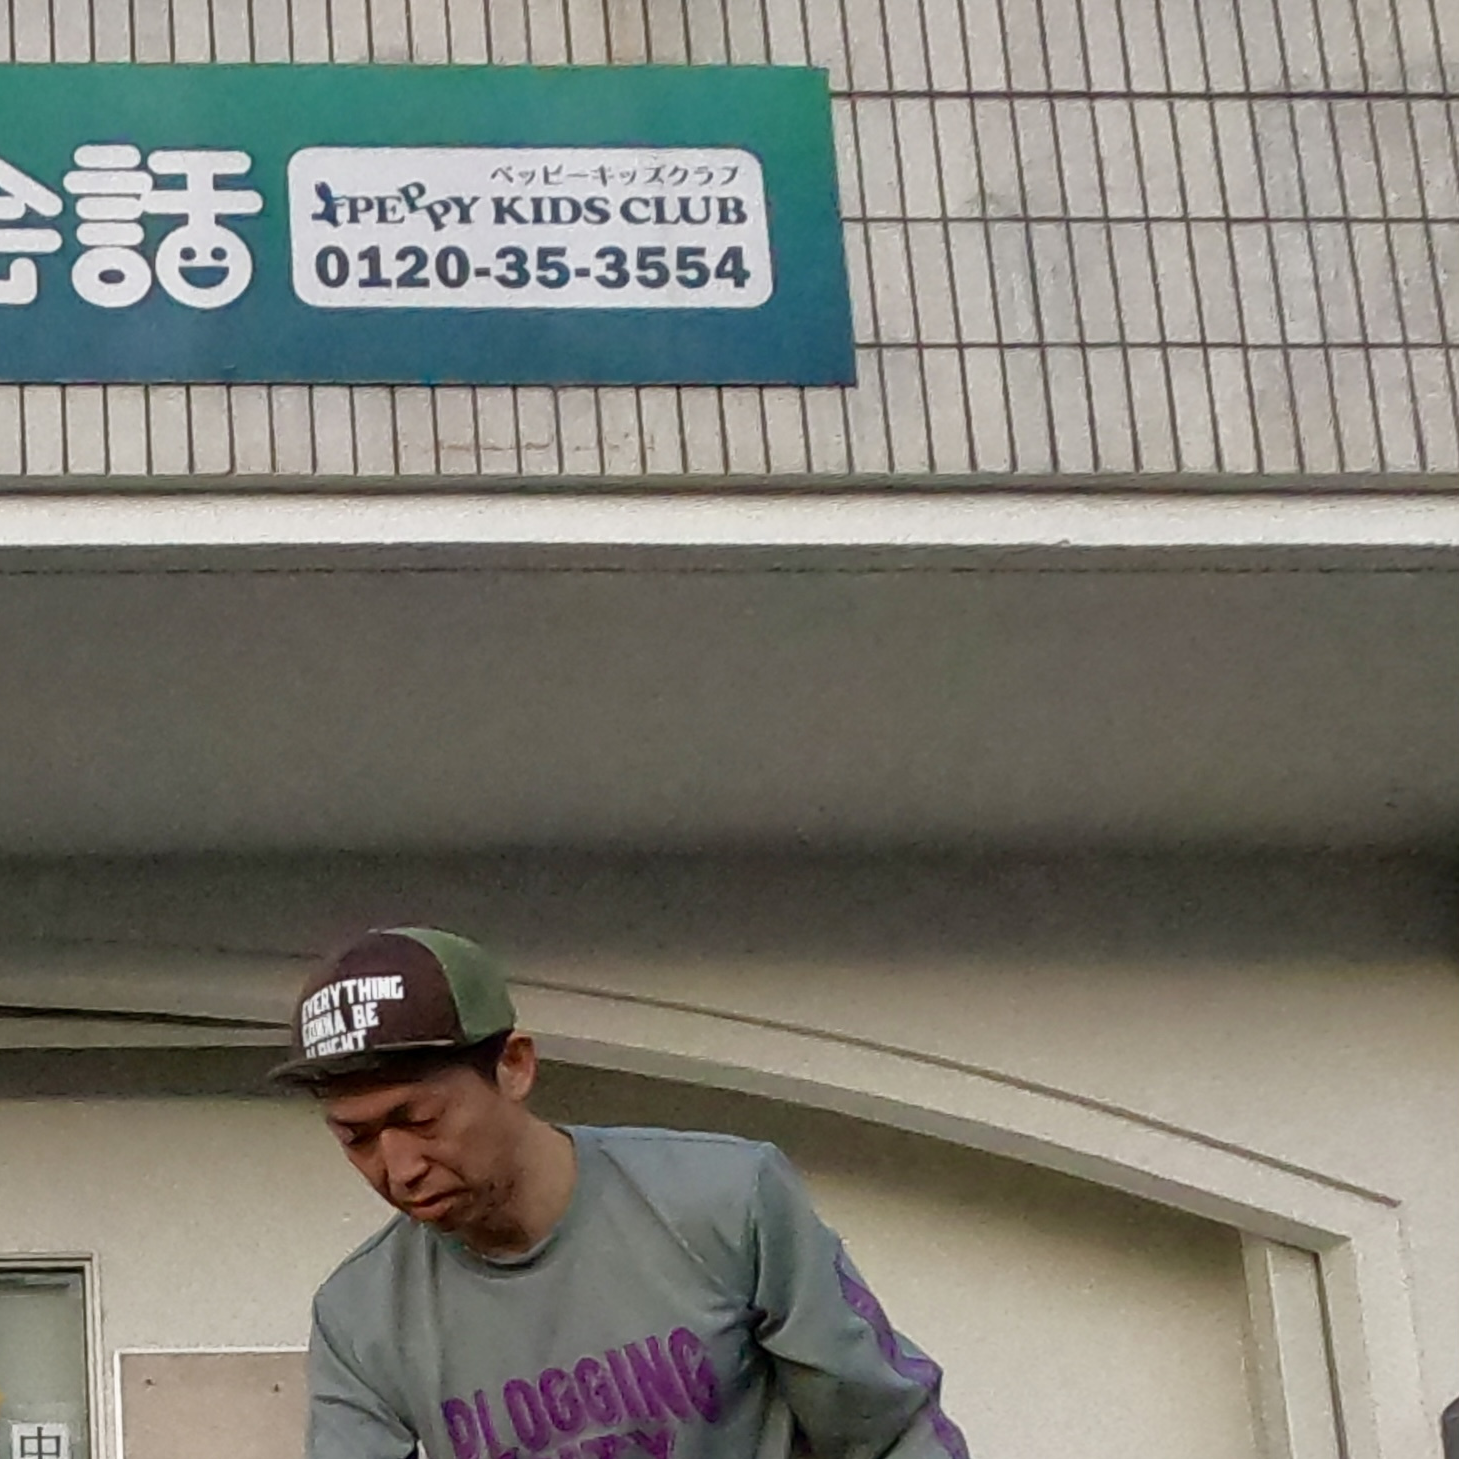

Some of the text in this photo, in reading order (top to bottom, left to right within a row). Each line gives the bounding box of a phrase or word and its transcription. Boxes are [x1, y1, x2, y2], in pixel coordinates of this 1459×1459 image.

[347, 181, 748, 231] PEPPY KIDS CLUB
[314, 245, 751, 289] 0120-35-3554
[302, 975, 405, 1024] EVERYTHING
[352, 1001, 380, 1030] BE
